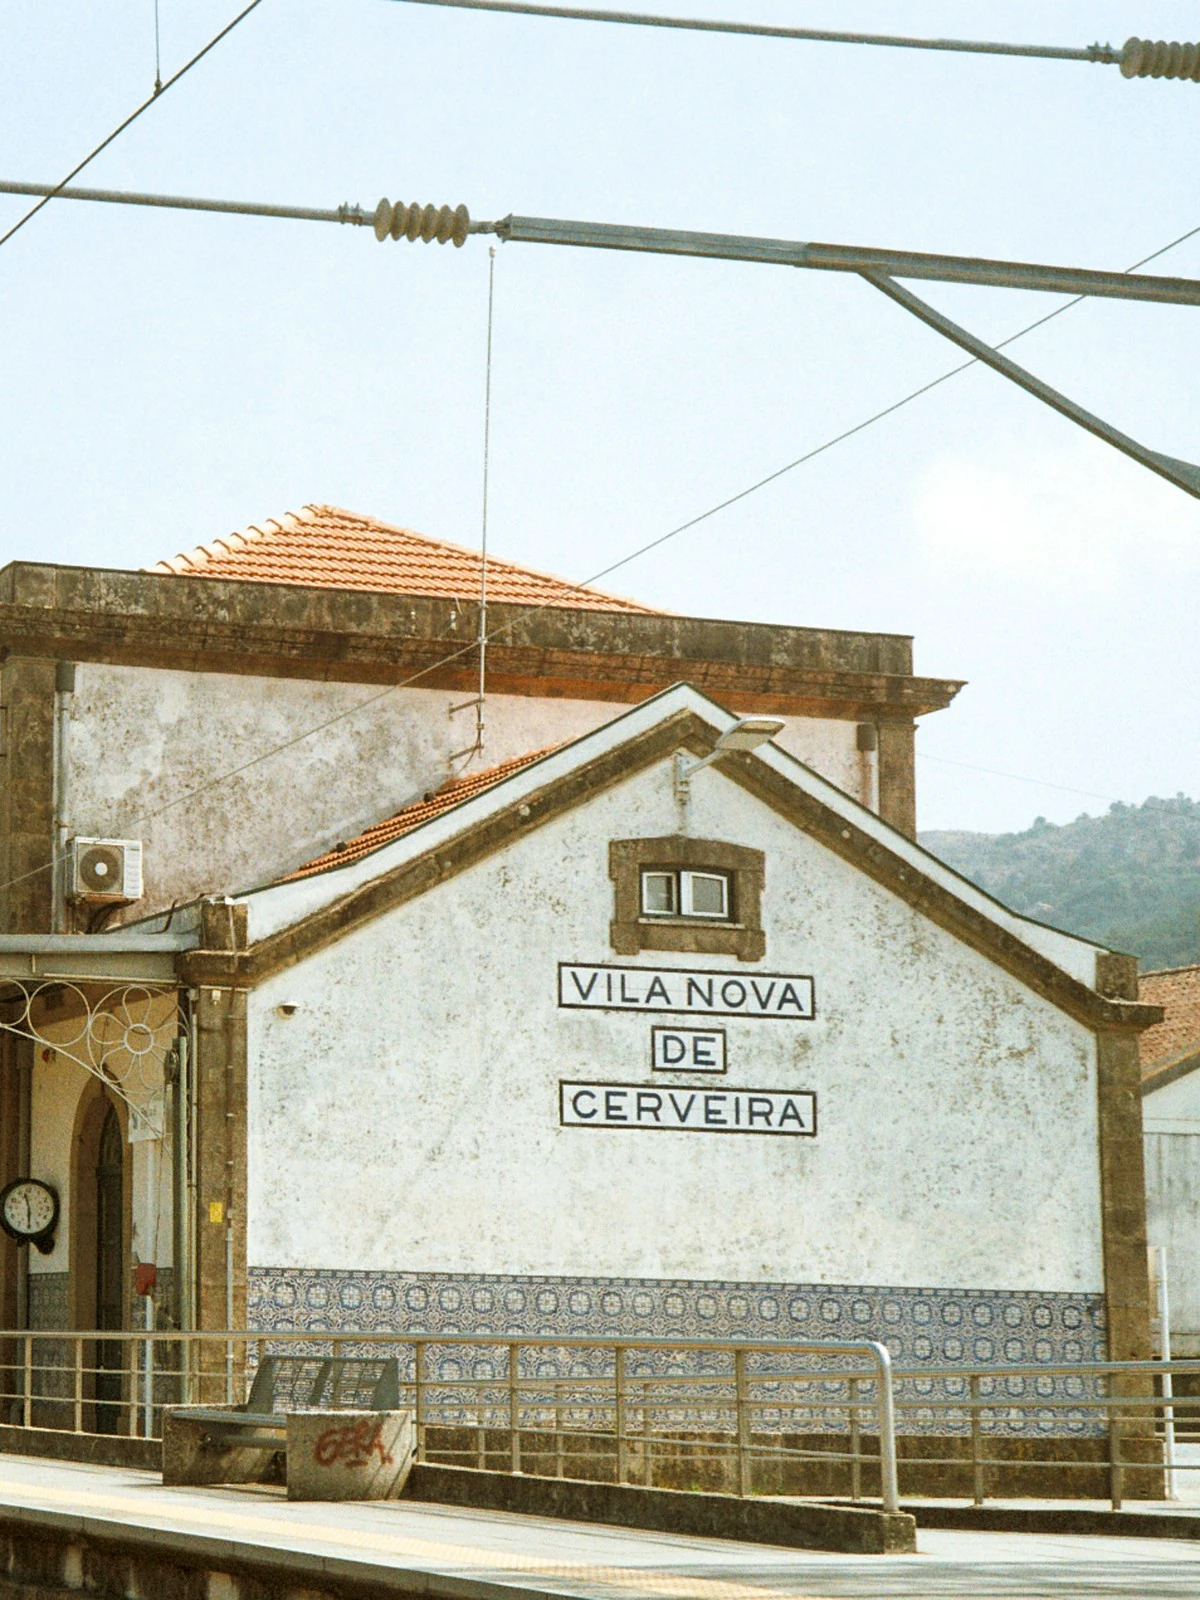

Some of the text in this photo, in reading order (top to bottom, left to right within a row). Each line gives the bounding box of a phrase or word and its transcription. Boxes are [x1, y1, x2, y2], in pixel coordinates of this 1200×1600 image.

[571, 971, 804, 1012] VILA NOVA
[662, 1034, 716, 1067] DE
[571, 1089, 806, 1129] CERVEIRA
